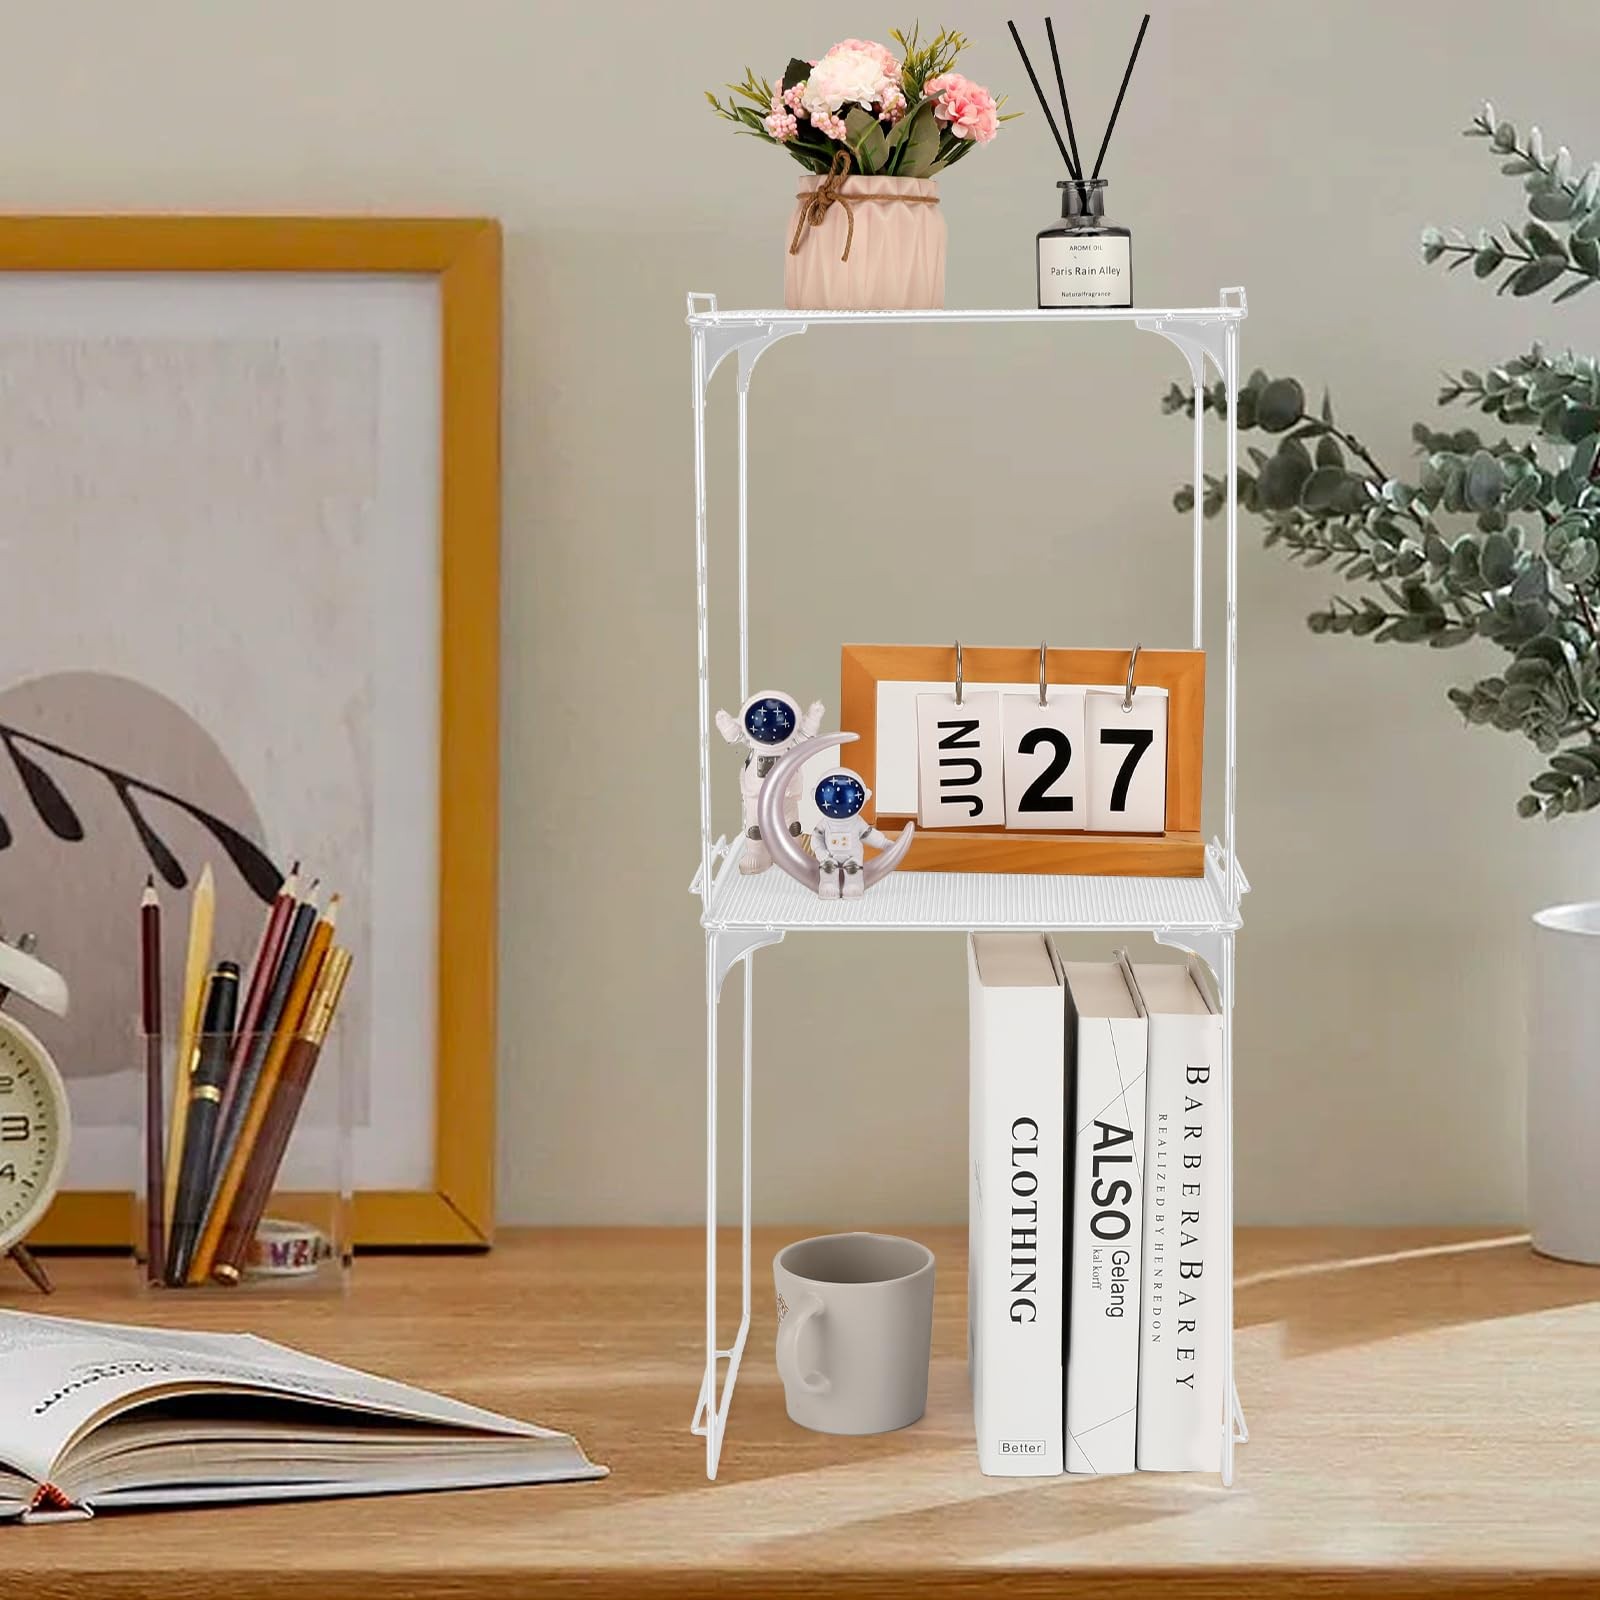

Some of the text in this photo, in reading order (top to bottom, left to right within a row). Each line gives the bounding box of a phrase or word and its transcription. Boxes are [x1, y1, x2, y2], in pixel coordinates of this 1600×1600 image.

[1051, 265, 1121, 277] Paris Rain Alley
[937, 719, 984, 817] JUN
[1155, 1113, 1168, 1207] REALIZED
[1009, 1116, 1039, 1325] CLOTHING
[1090, 1119, 1134, 1318] ALSO Gelang
[1151, 1243, 1164, 1343] HENREDON
[1002, 1442, 1042, 1453] Better
